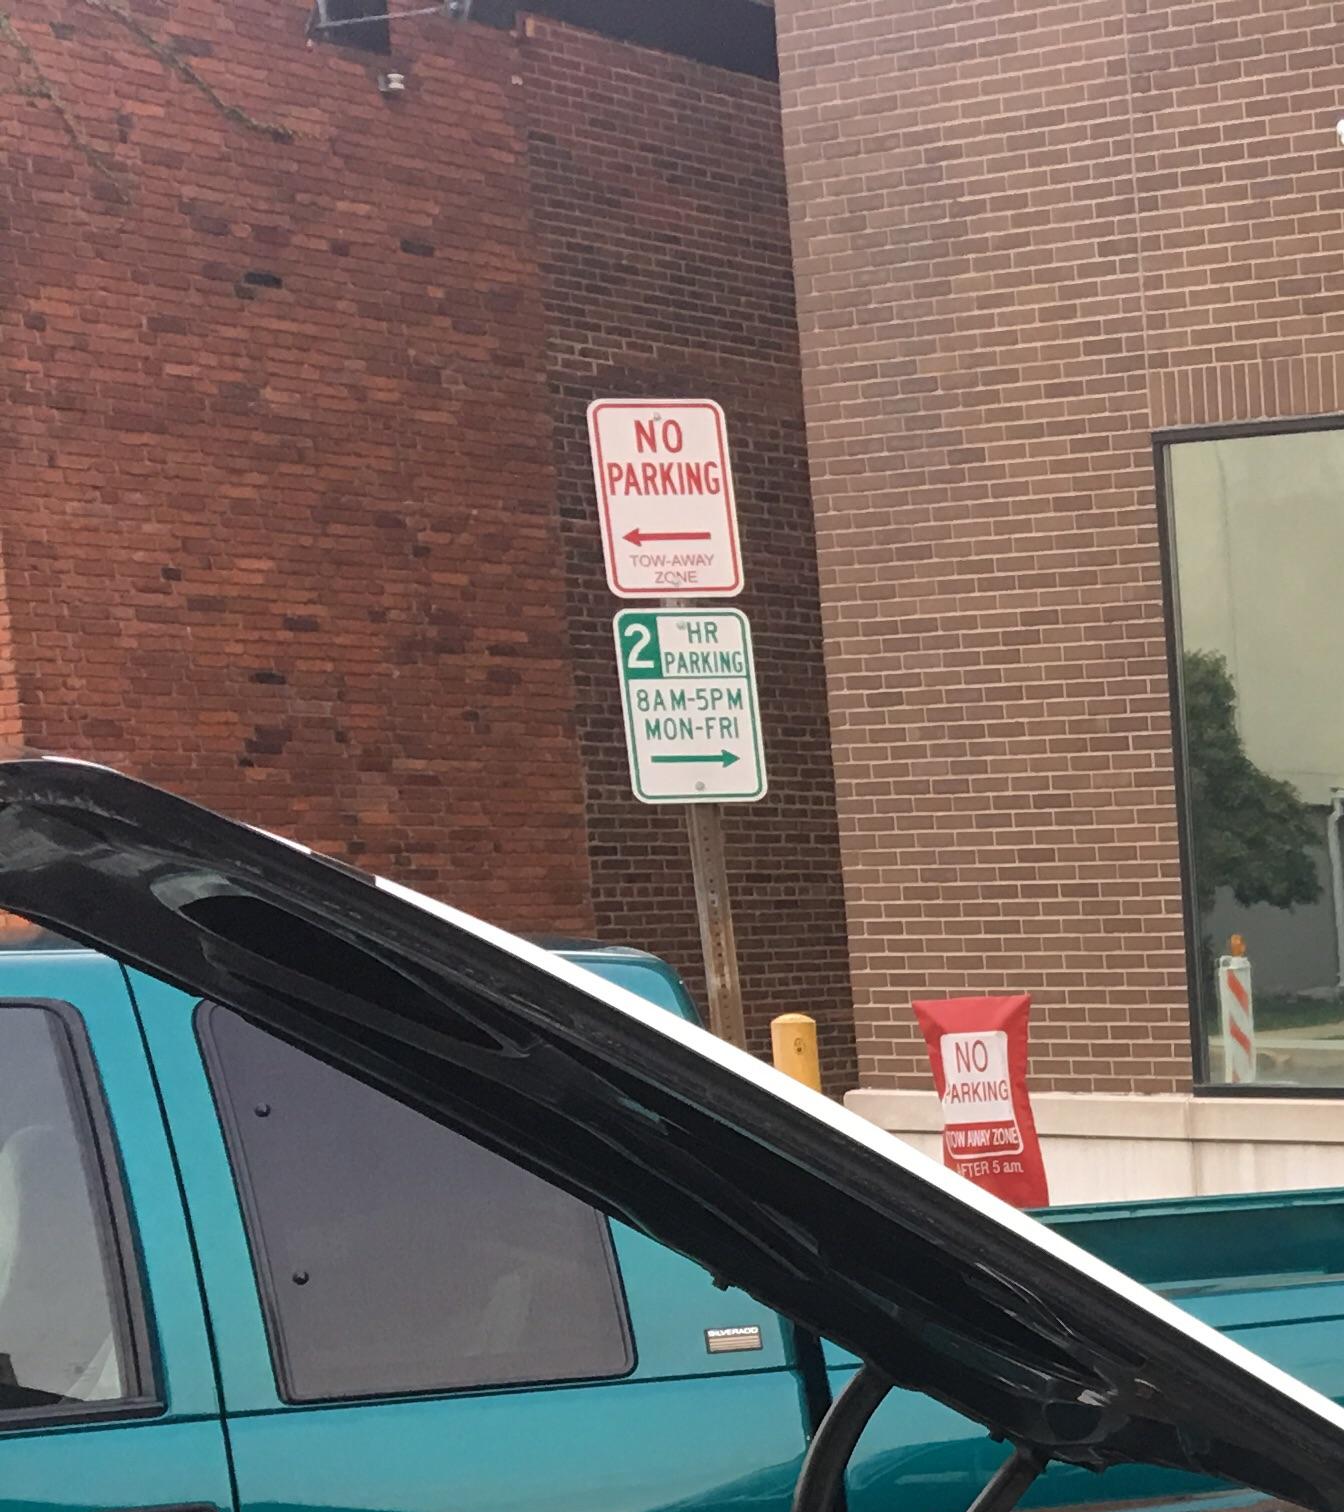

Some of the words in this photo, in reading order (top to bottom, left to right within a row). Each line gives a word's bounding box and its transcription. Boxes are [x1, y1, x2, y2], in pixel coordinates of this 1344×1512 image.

[634, 419, 683, 453] NO
[608, 462, 721, 496] PARKING
[629, 553, 714, 568] TOW-AWAY
[654, 569, 698, 584] ZONE
[623, 623, 656, 669] 2
[687, 622, 719, 644] HR
[664, 651, 744, 674] PARKING
[636, 688, 744, 712] 8AM-5PM
[645, 717, 739, 740] MON-FRI
[954, 1039, 988, 1074] NO
[967, 1129, 991, 1147] AWAY
[992, 1127, 1018, 1145] ZONE
[956, 1161, 990, 1177] FTER
[992, 1160, 1001, 1174] 5
[707, 1326, 759, 1337] SILVERADO
